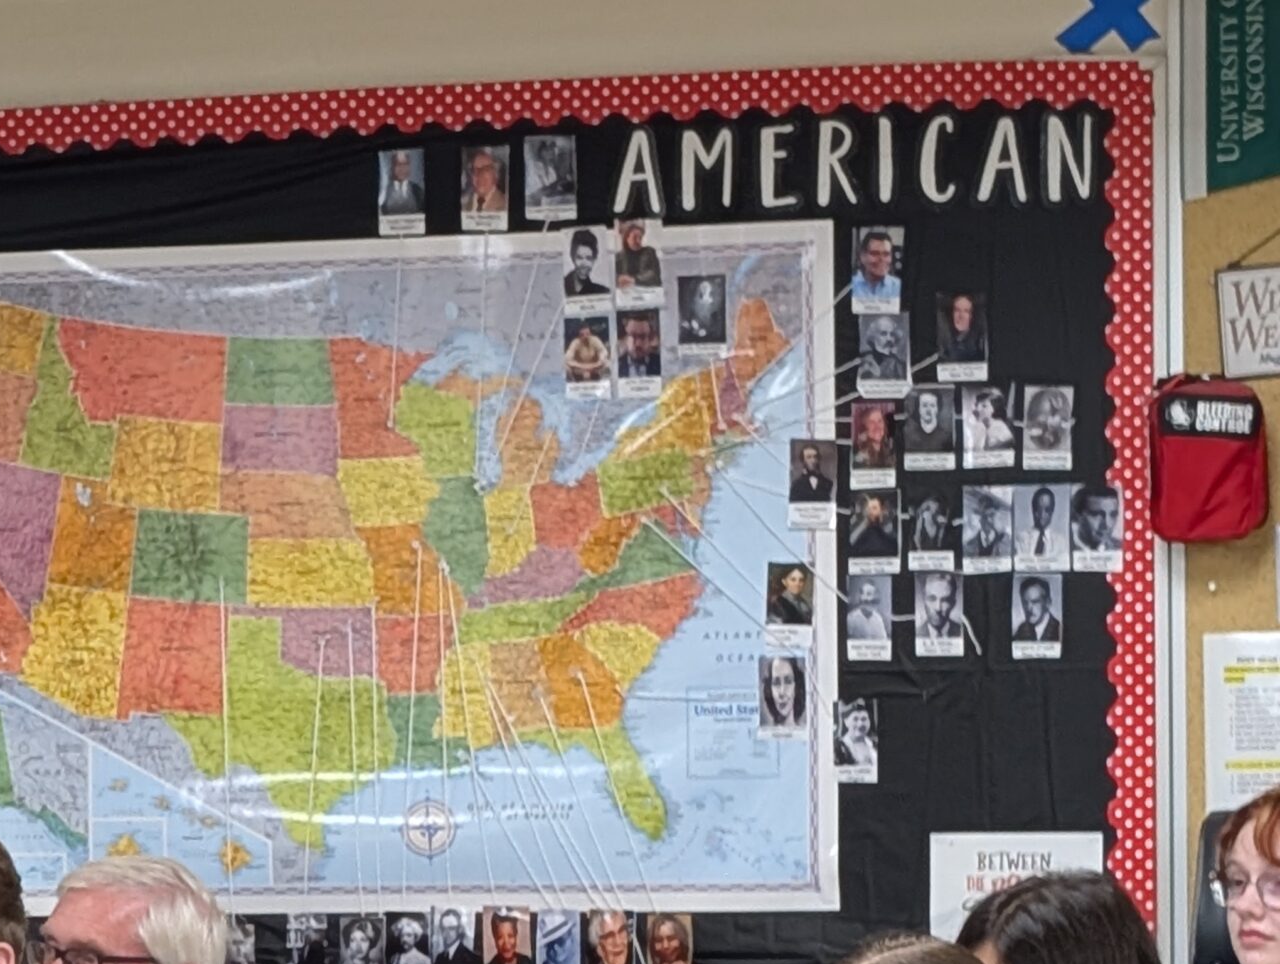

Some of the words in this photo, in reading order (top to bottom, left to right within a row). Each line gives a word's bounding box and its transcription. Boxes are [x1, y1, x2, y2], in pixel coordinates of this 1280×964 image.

[1217, 13, 1240, 163] UNIVERSITY
[613, 115, 1093, 213] AMERICAN
[1197, 400, 1253, 420] BLEEDING
[1195, 416, 1251, 434] CONTROL
[694, 704, 734, 716] United
[977, 851, 1052, 871] BETWEEN
